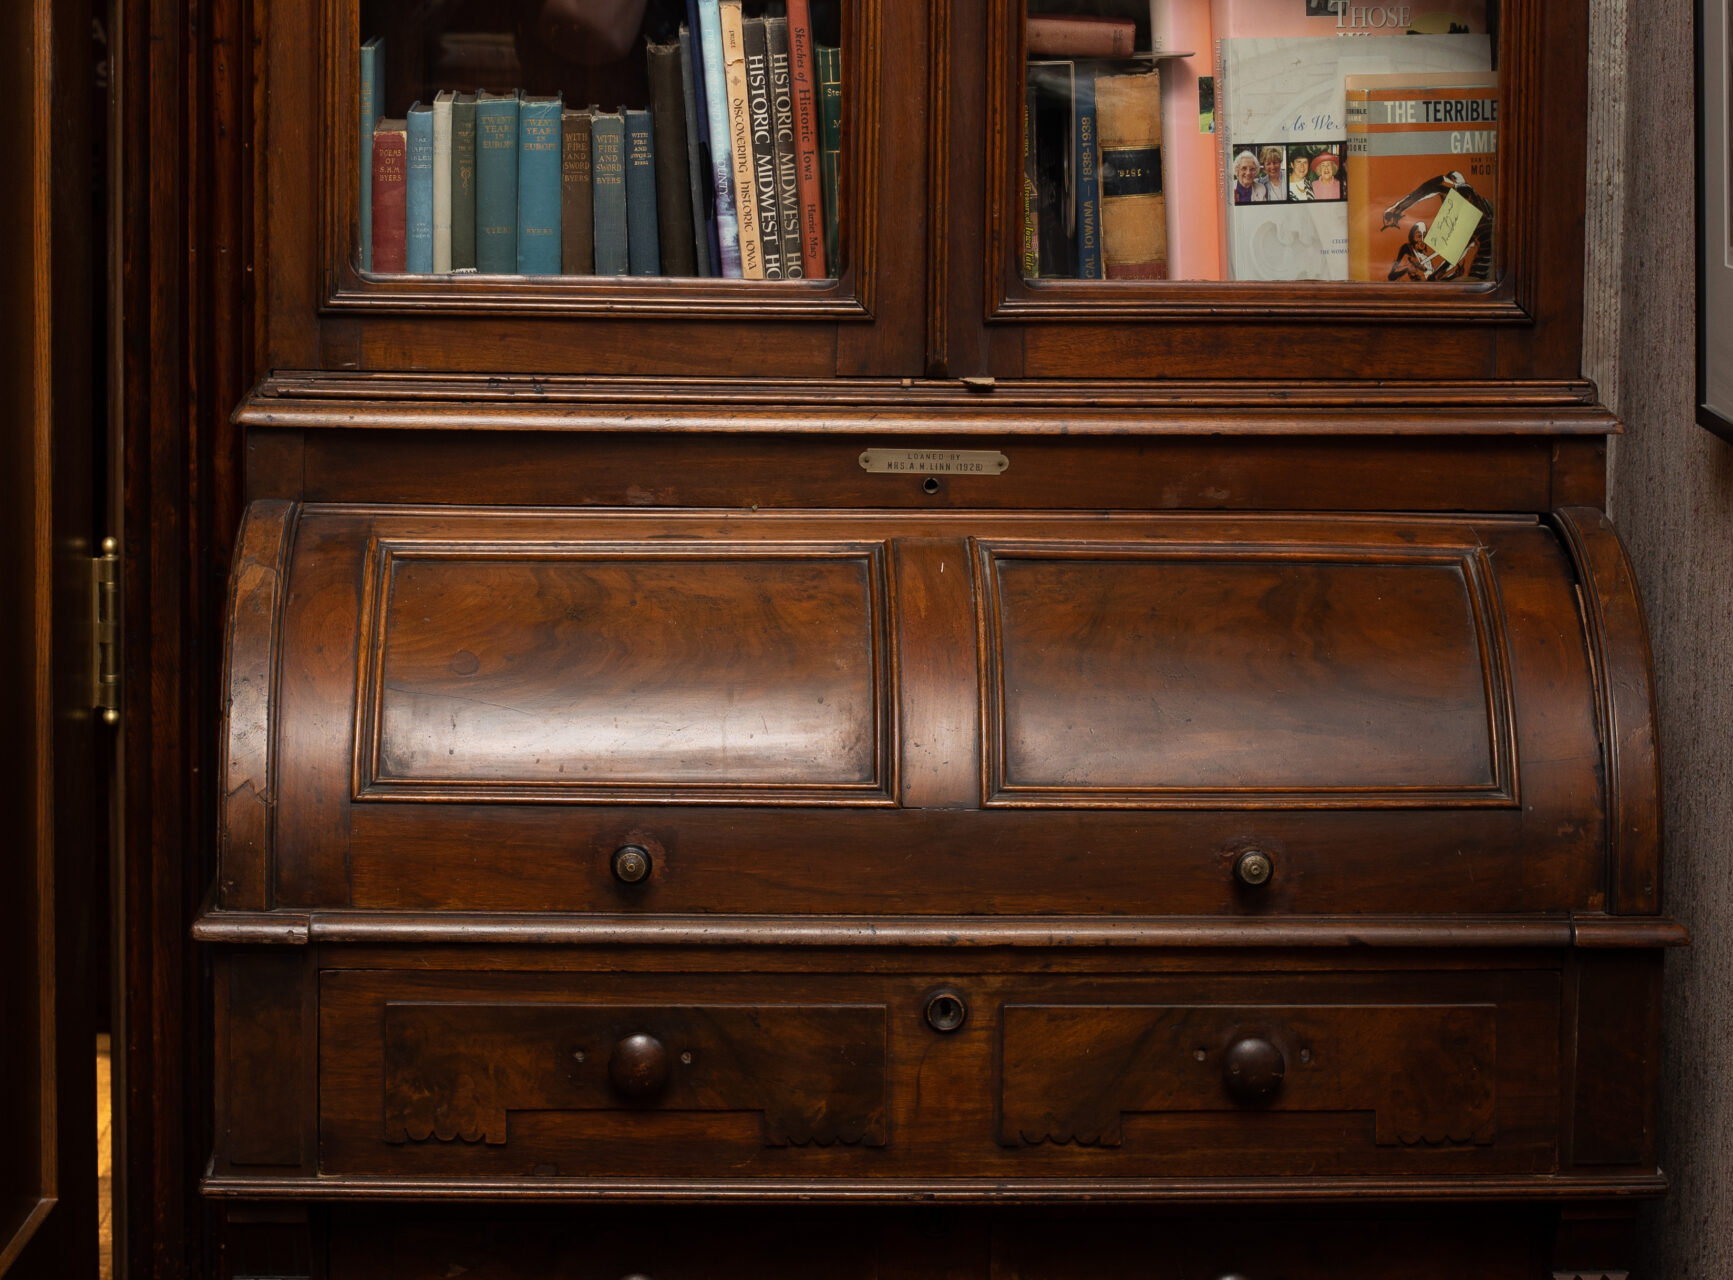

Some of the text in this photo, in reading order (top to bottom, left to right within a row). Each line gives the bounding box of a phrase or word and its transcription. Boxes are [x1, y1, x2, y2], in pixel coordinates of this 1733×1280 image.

[1331, 0, 1412, 28] THOSE
[773, 53, 794, 143] HISTORIC
[1384, 99, 1498, 124] THE TERRIBLE
[1281, 114, 1333, 131] As We
[566, 133, 588, 141] WITH
[567, 142, 587, 150] FIRE
[596, 135, 619, 143] WITH
[795, 27, 819, 259] Sketches of Historic Iowa Harriet Mary
[379, 149, 402, 157] POEMS
[598, 145, 618, 153] FIRE
[748, 55, 779, 245] HISTORIC MIDWEST
[1081, 116, 1093, 183] 1838-1938
[564, 161, 590, 170] SWORD
[596, 163, 622, 172] SWORD
[716, 152, 729, 197] COUNTY
[379, 174, 402, 182] BYERS
[779, 151, 800, 243] MIDWEST
[1083, 199, 1095, 249] IOWANA
[1025, 225, 1035, 249] Iowa
[887, 461, 905, 470] MRS
[909, 462, 915, 470] A
